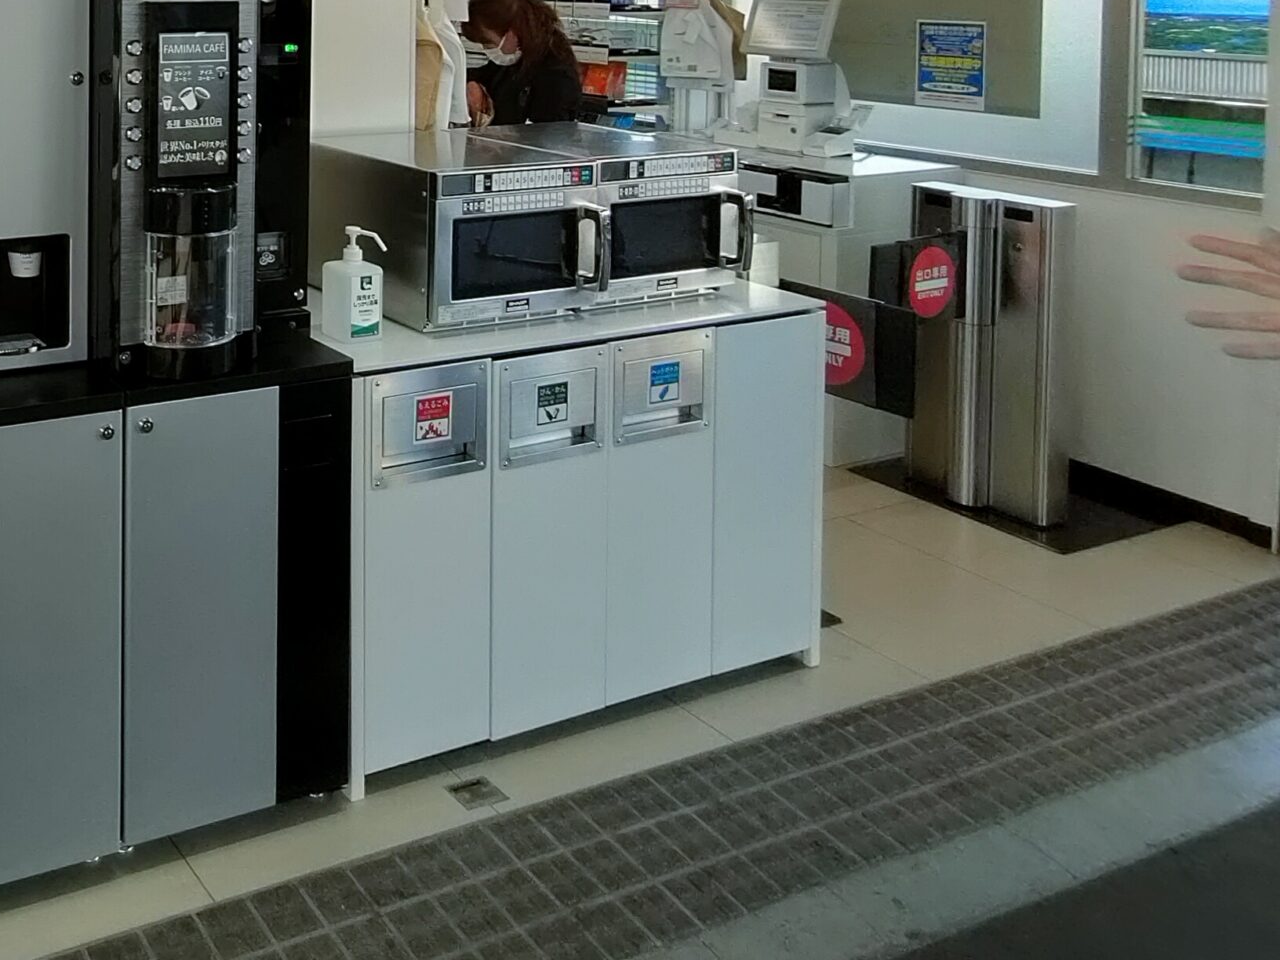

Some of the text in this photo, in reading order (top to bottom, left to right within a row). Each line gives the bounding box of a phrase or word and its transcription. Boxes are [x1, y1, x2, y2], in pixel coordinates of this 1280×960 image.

[163, 43, 201, 54] FAMIMA
[915, 265, 948, 281] 出口専用
